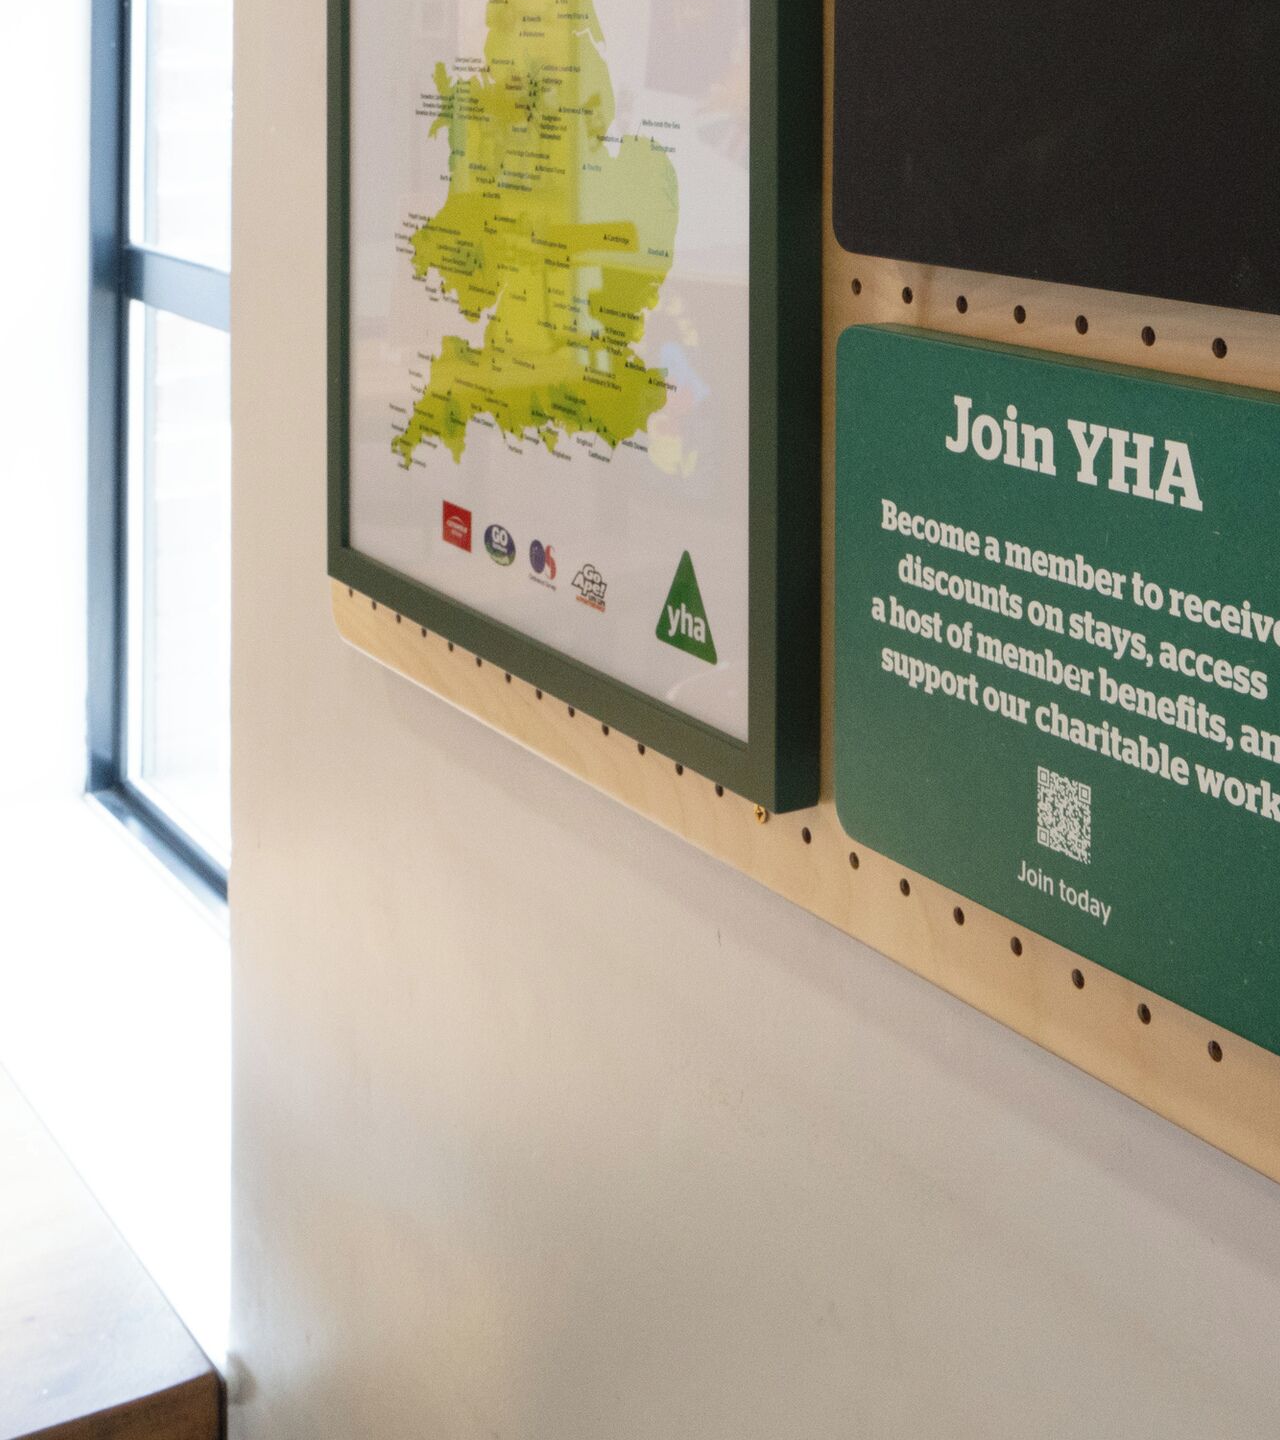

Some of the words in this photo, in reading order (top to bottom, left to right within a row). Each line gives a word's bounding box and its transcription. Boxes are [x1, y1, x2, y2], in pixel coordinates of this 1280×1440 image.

[945, 394, 1057, 477] Join
[1067, 418, 1204, 512] YHA
[492, 527, 508, 546] GO
[583, 564, 603, 584] Go
[881, 498, 981, 557] Become
[984, 535, 1001, 564] a
[1004, 540, 1127, 601] member
[1131, 571, 1164, 611] to
[572, 572, 607, 600] Ape!
[667, 604, 706, 643] yha
[897, 553, 1024, 620] discounts
[1027, 600, 1065, 635] on
[1068, 610, 1154, 668] stays,
[1158, 641, 1268, 700] access
[871, 596, 887, 623] a
[889, 595, 943, 644] host
[946, 621, 974, 654] of
[976, 632, 1095, 697] member
[1098, 666, 1234, 751] benefits,
[881, 647, 979, 706] support
[982, 685, 1031, 725] our
[1034, 701, 1190, 786] charitable
[1017, 860, 1054, 896] Join
[1058, 878, 1112, 926] today
